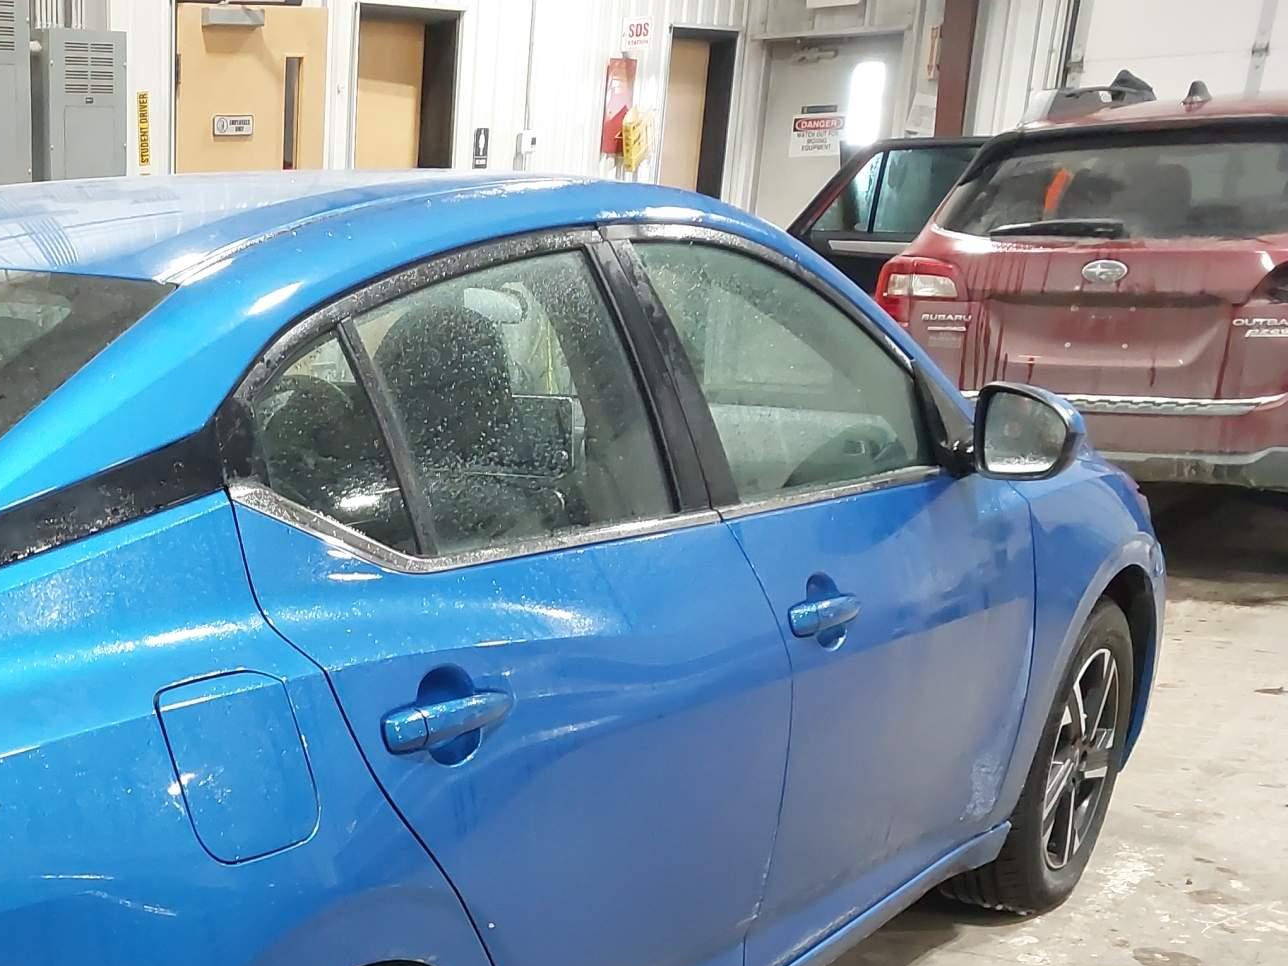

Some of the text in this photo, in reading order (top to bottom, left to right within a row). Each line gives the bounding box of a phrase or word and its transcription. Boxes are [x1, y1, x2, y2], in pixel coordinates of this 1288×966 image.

[628, 23, 649, 38] SDS
[139, 93, 149, 163] STUDENT DRIVER
[801, 119, 838, 129] DANGER
[921, 313, 972, 322] SUBARU
[1232, 318, 1288, 326] OUTBA
